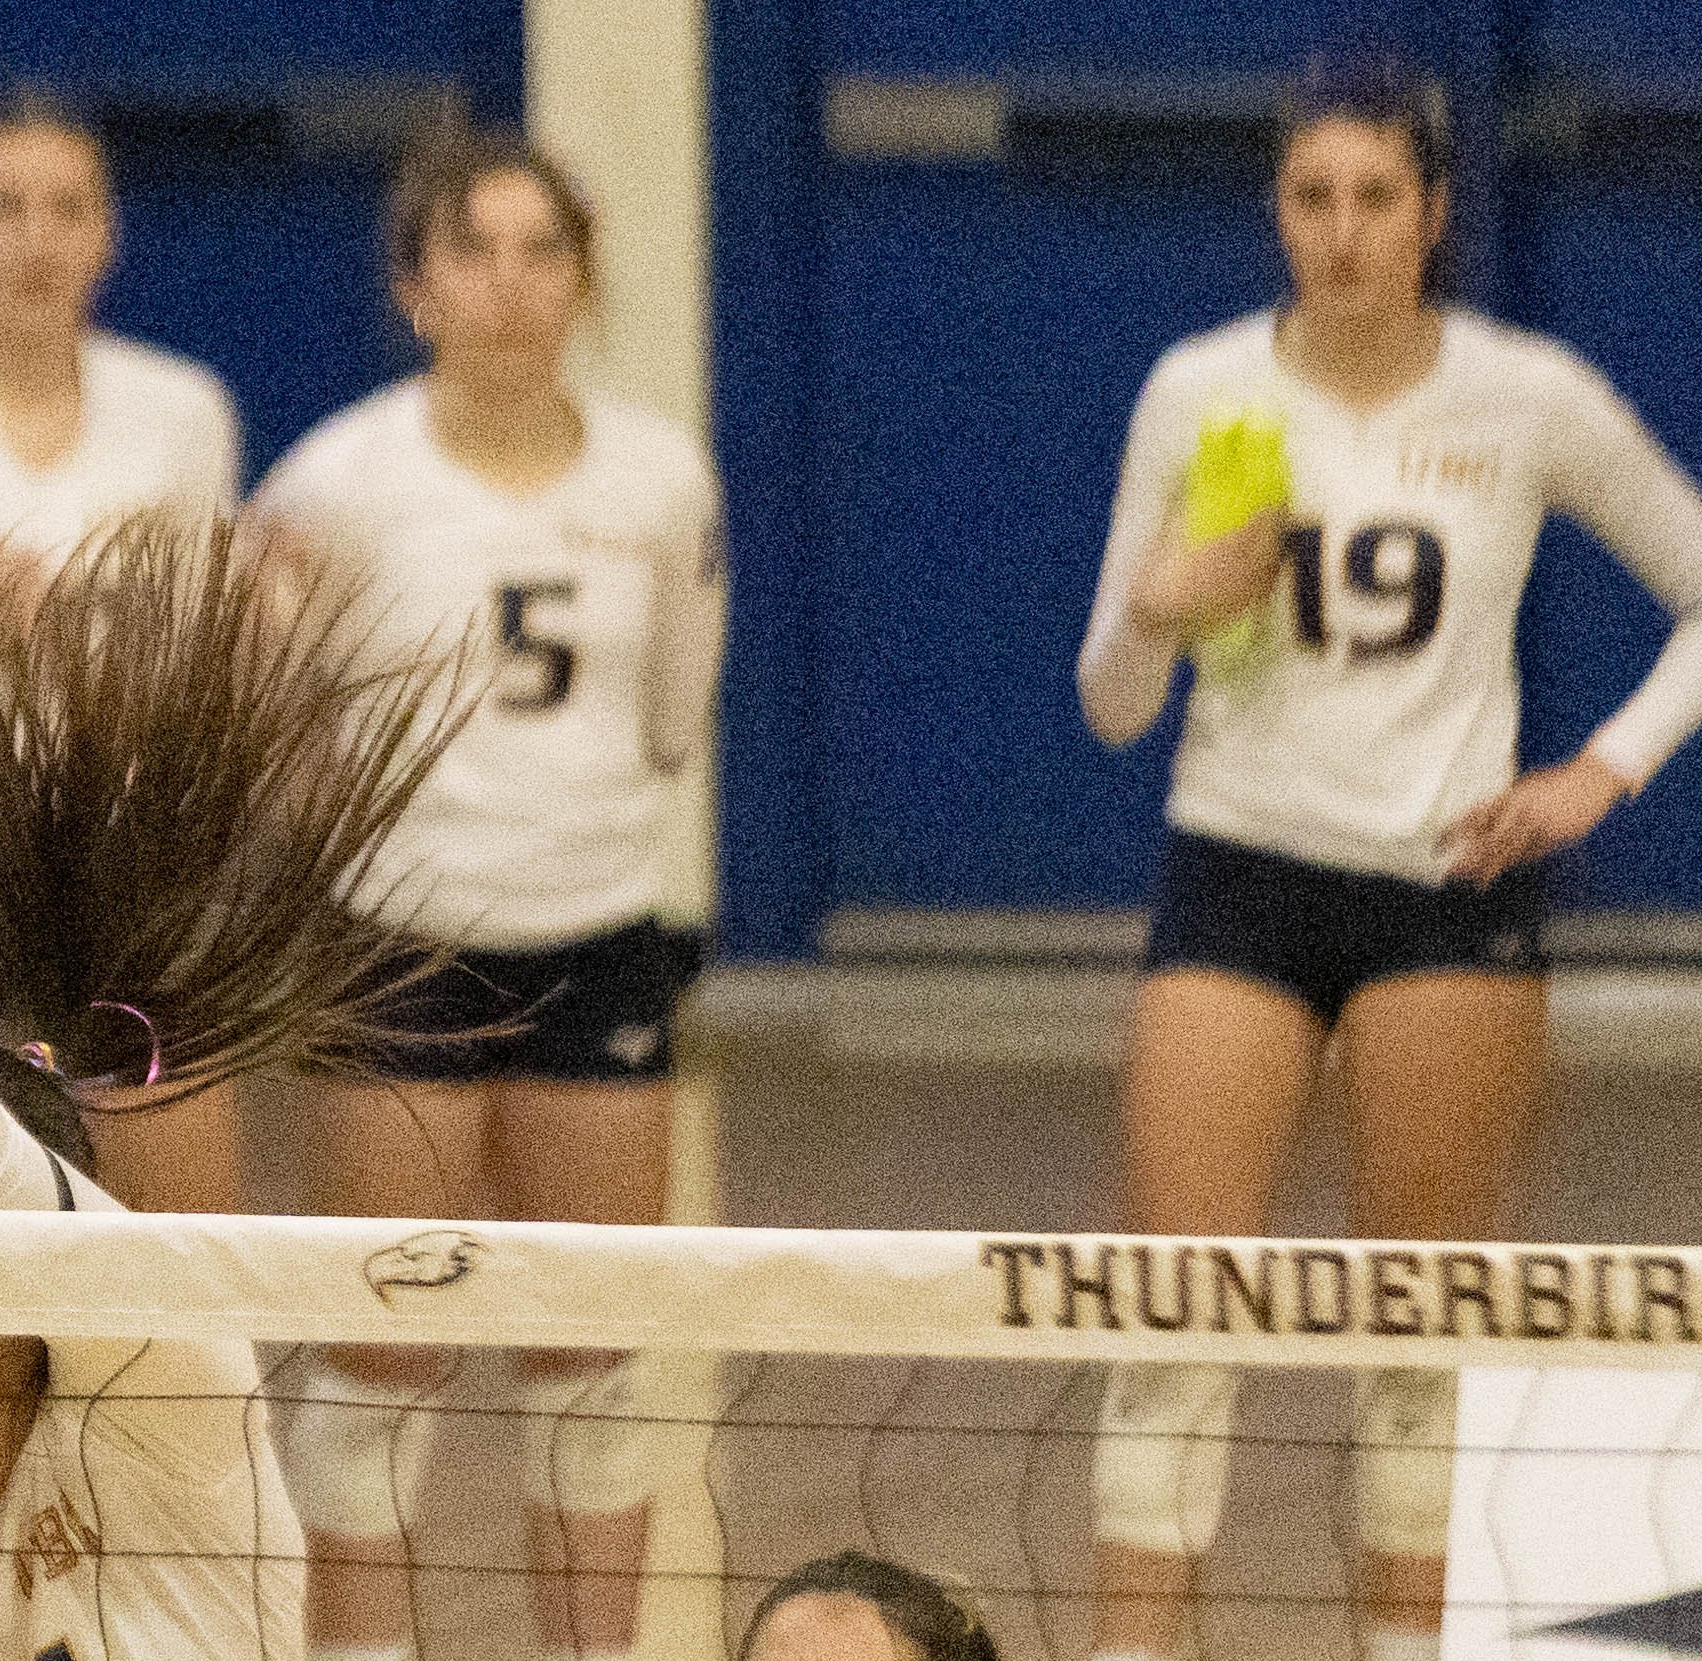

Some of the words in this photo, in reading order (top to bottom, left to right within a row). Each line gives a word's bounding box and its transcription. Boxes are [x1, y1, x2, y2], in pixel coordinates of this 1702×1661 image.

[496, 577, 577, 720] 5
[1281, 518, 1446, 664] 19
[980, 1240, 1701, 1343] THUNDERBIR
